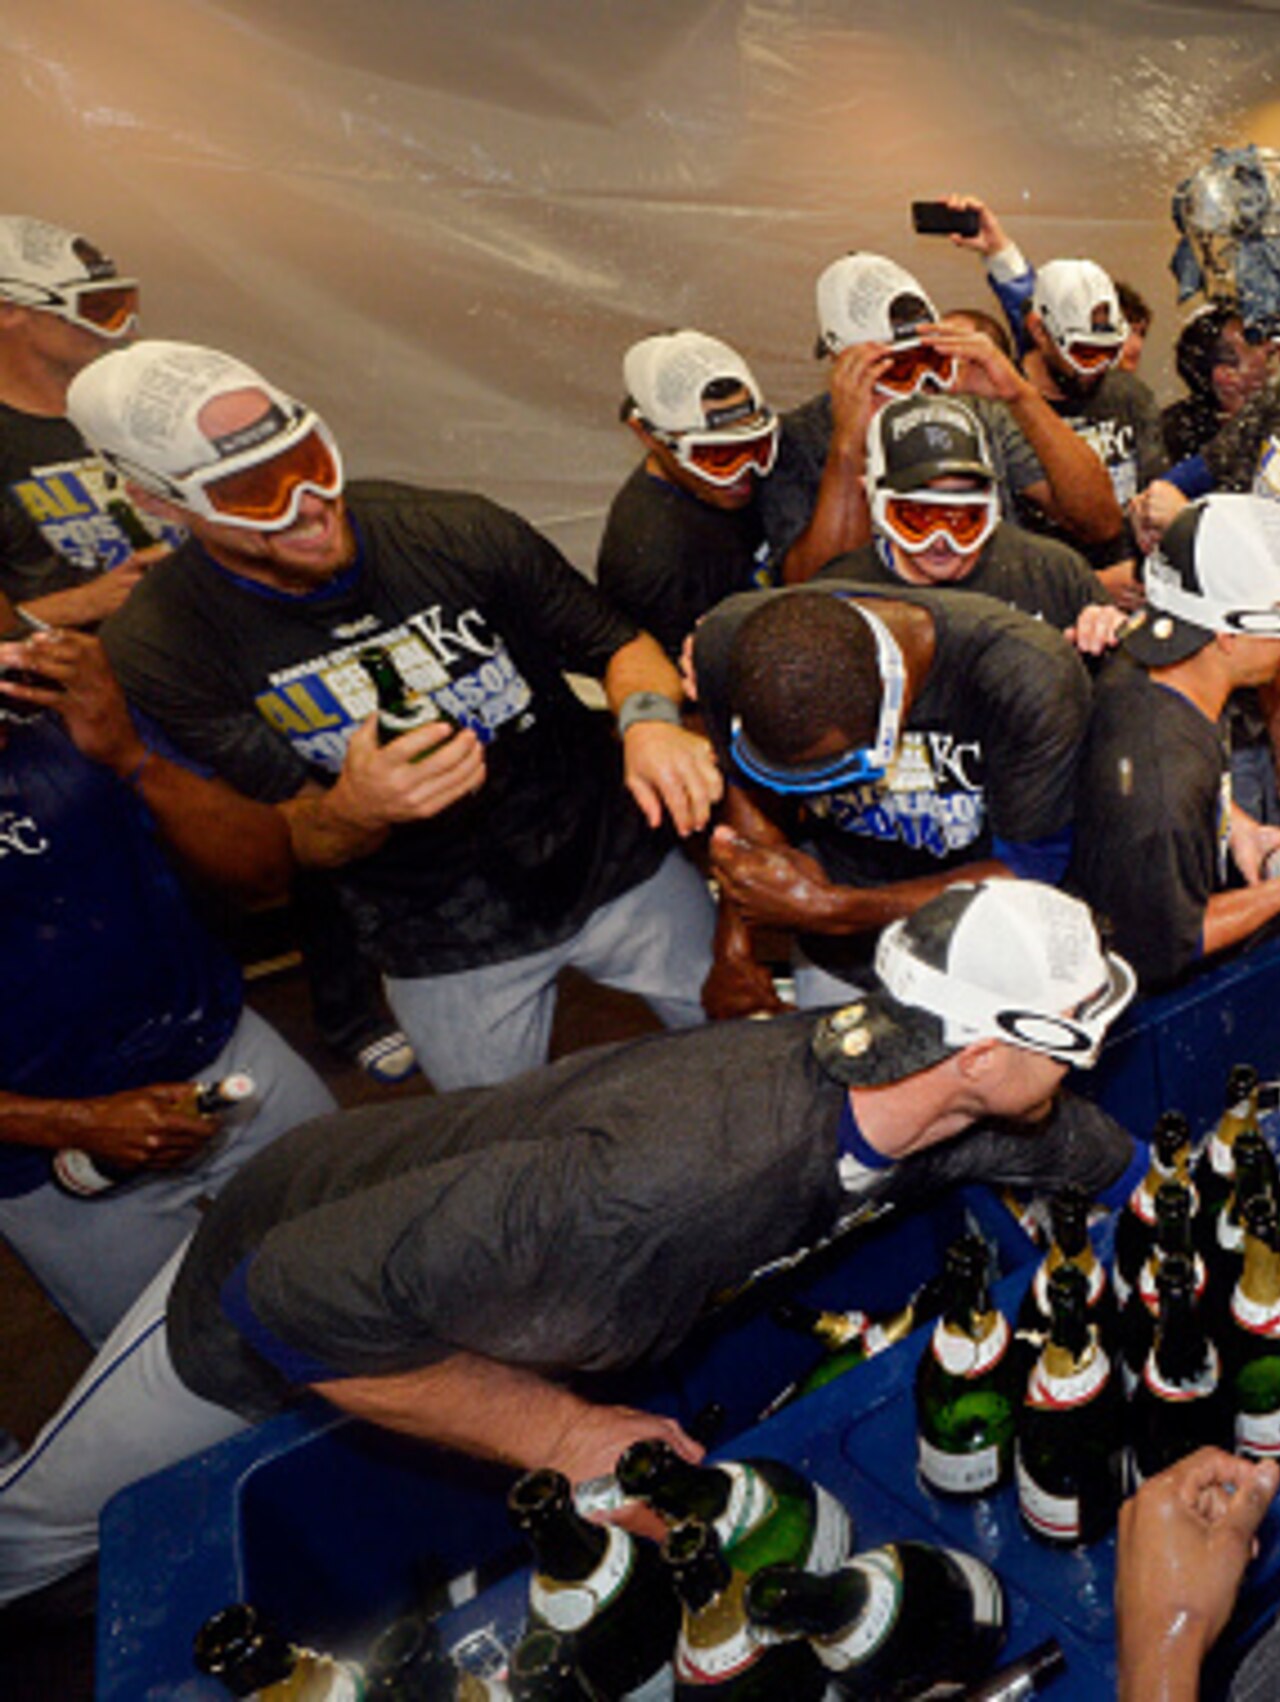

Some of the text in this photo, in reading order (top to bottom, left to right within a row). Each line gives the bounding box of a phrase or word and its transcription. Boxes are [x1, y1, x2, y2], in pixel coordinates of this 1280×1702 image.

[14, 476, 92, 522] AL
[406, 604, 504, 664] KC
[254, 682, 343, 736] AL
[928, 730, 985, 794] KC
